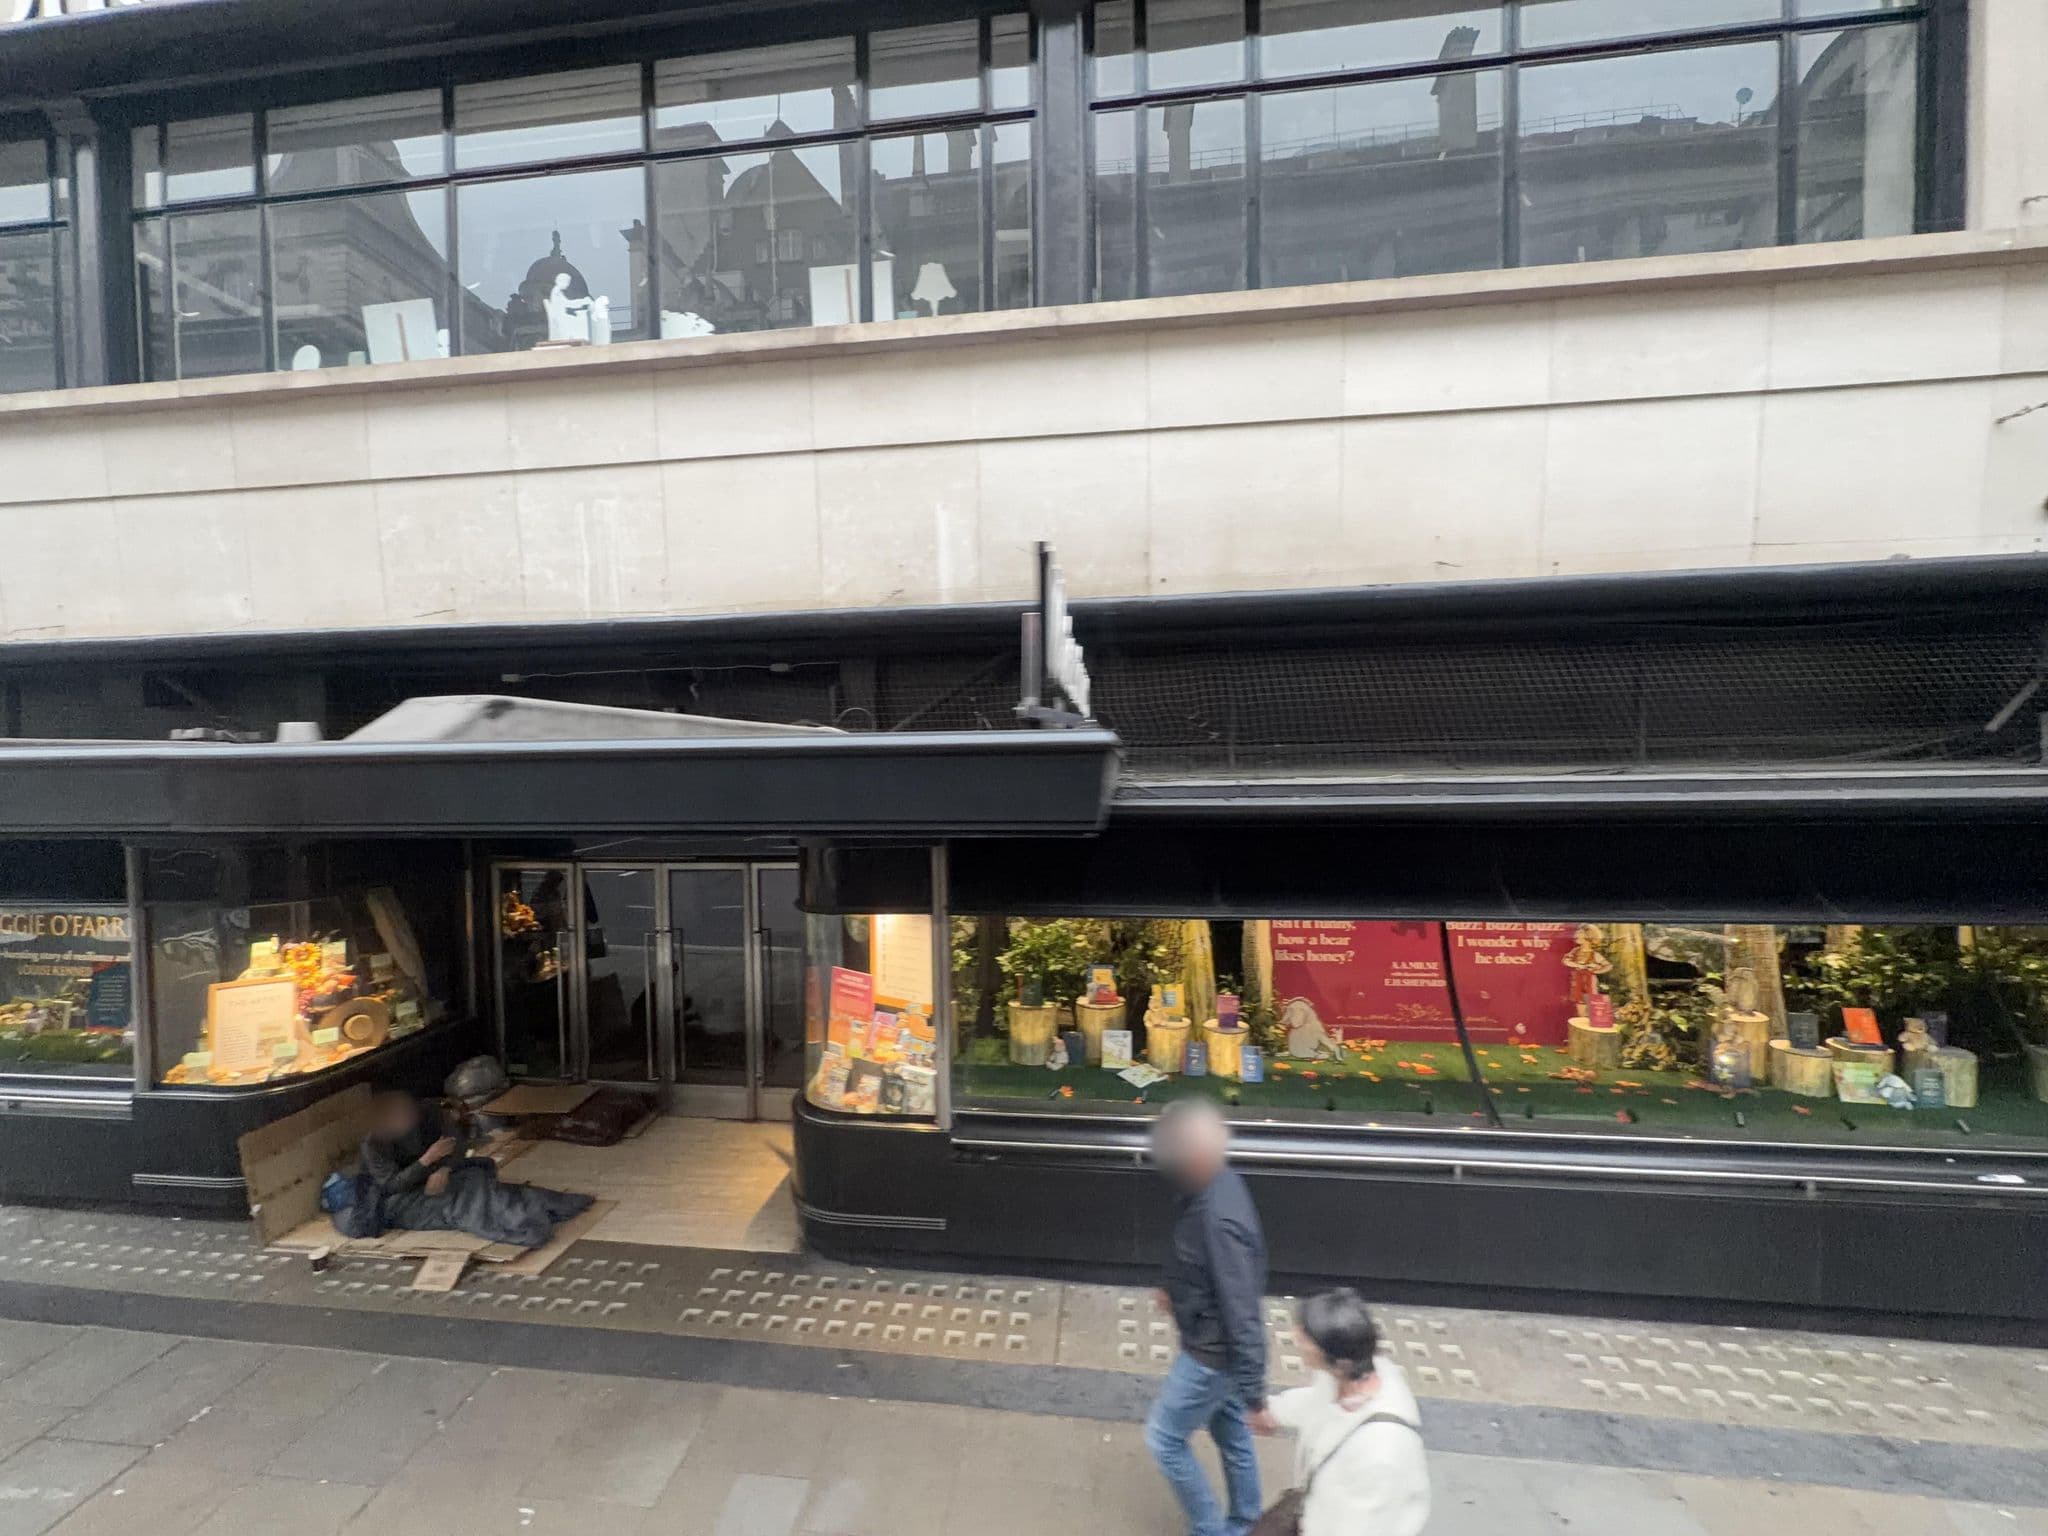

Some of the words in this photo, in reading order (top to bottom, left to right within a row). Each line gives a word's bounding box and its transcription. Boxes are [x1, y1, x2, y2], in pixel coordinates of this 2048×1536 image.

[50, 914, 129, 938] O'FARR
[1277, 933, 1306, 945] how
[1308, 936, 1318, 946] a
[1319, 933, 1351, 946] bear
[1457, 935, 1464, 947] I
[1466, 935, 1519, 948] wonder
[1520, 935, 1552, 951] why
[1274, 949, 1305, 961] likes
[1306, 949, 1355, 965] honey?
[1474, 951, 1493, 964] he
[1494, 951, 1536, 964] does?
